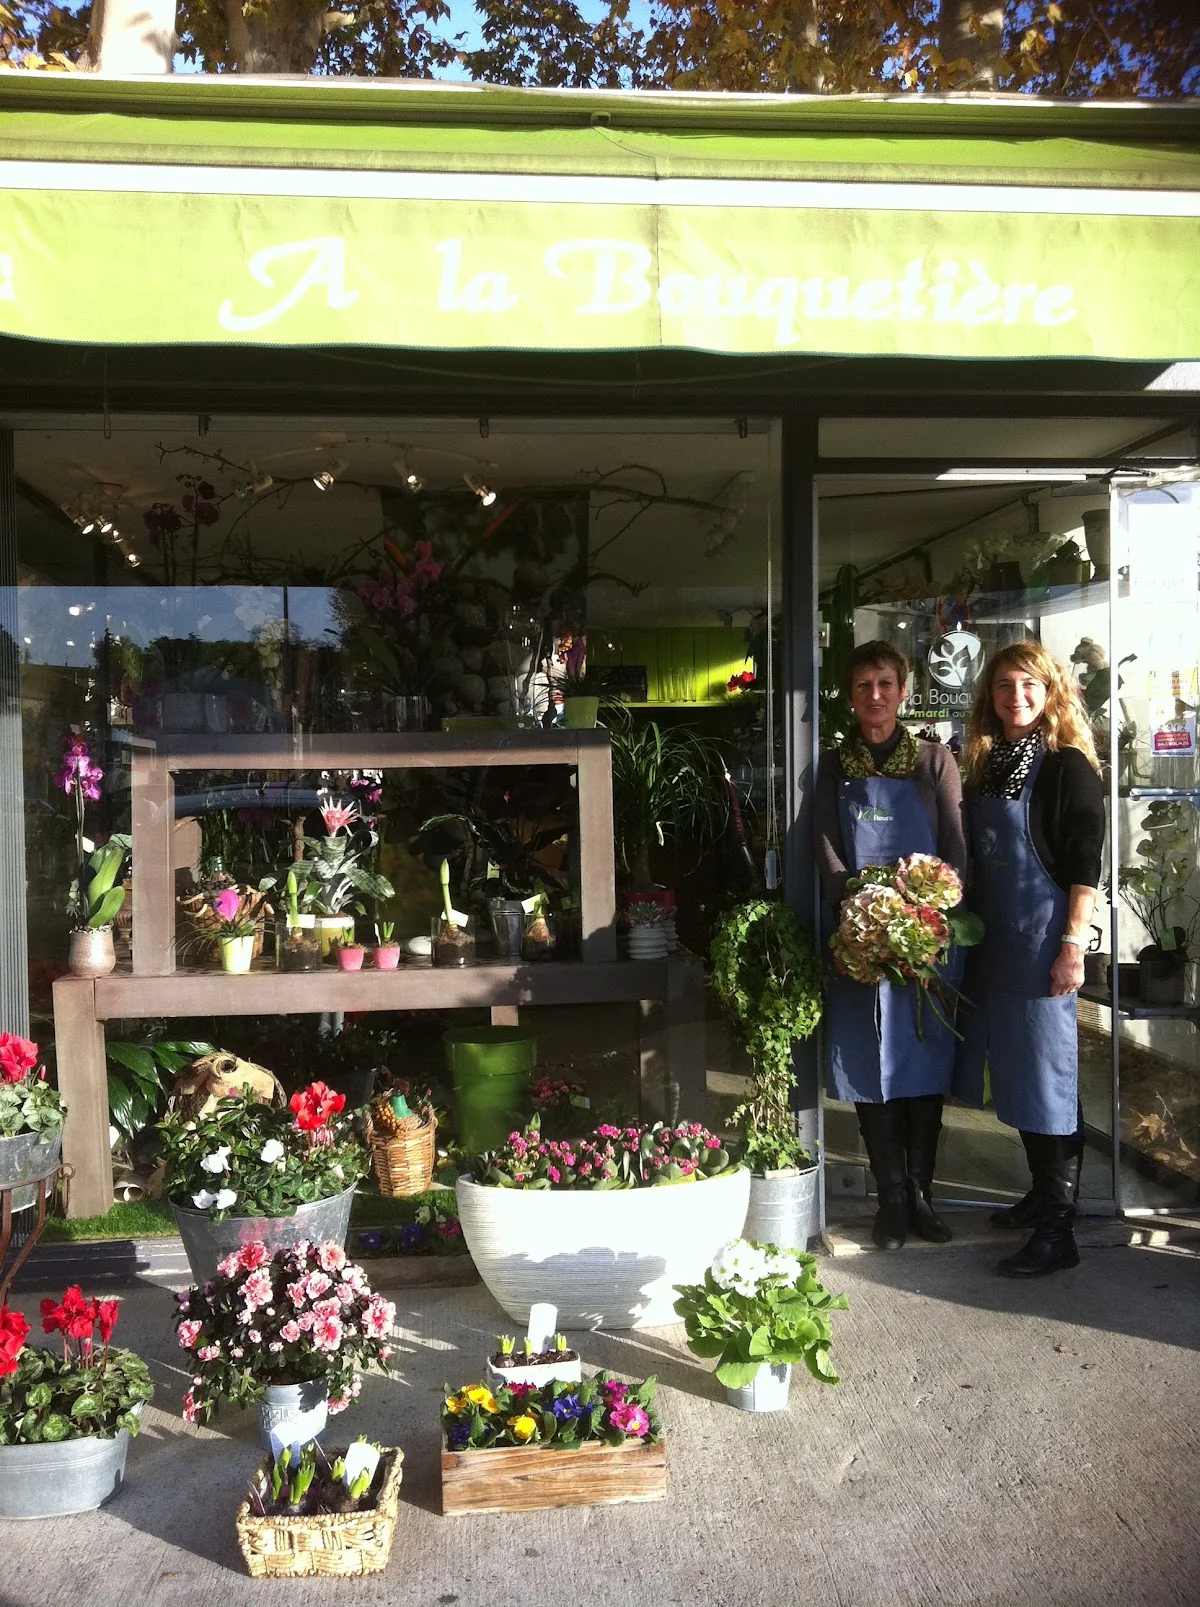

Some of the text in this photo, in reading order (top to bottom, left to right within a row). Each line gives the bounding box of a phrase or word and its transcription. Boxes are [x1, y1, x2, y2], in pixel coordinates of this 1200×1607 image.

[218, 236, 1079, 346] A la Bouquetière
[929, 688, 975, 709] Bouqu
[914, 709, 949, 718] mardi
